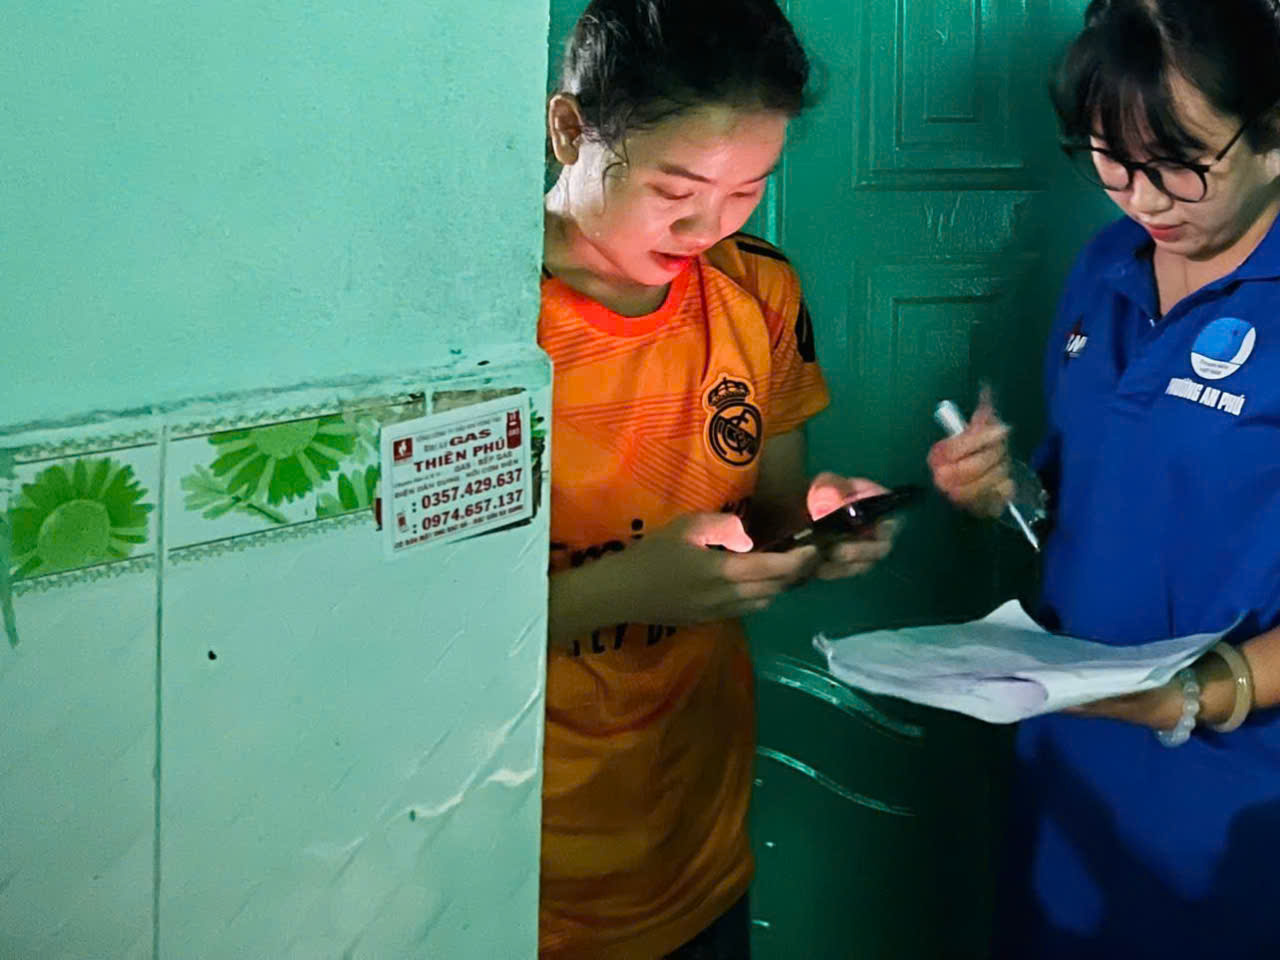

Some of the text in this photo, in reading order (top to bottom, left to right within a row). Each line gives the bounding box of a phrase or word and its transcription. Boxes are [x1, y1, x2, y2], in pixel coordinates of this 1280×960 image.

[1199, 386, 1221, 408] AN
[1217, 390, 1246, 416] PHÚ
[414, 449, 467, 472] THIÊN
[473, 436, 505, 457] PHÚ
[449, 428, 492, 447] GAS
[421, 467, 523, 510] 0357.429.637
[421, 488, 524, 531] 0974.657.137
